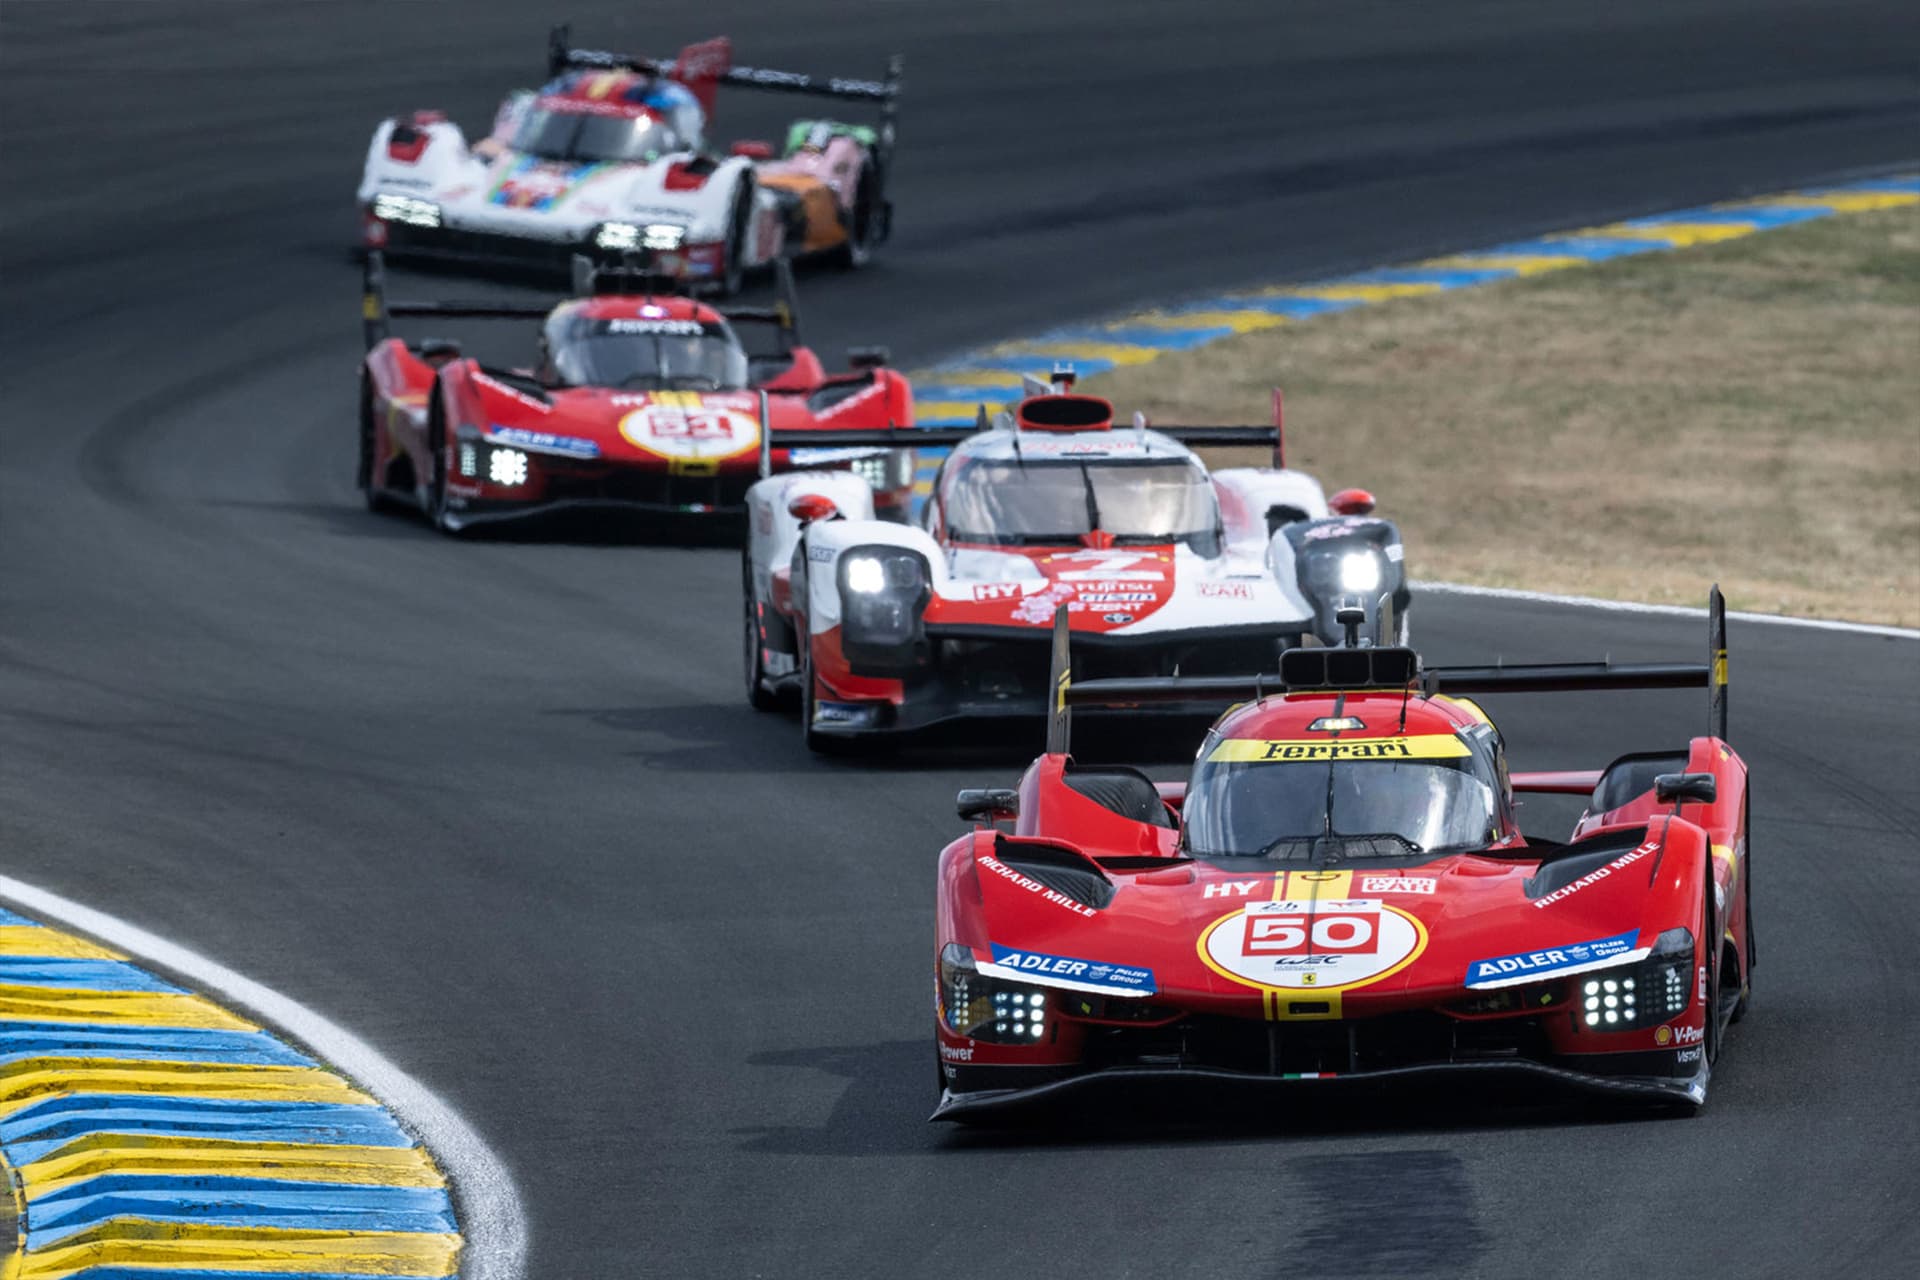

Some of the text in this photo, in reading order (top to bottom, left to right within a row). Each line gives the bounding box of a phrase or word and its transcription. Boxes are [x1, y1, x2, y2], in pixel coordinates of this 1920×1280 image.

[976, 584, 1019, 599] HY
[1260, 740, 1412, 759] Ferrari
[978, 856, 1097, 917] RICHARD MILLE
[1534, 841, 1660, 908] RICHARD MILLE
[1203, 880, 1260, 898] HY
[1250, 916, 1373, 950] 50
[996, 953, 1088, 976] ADLER
[1478, 950, 1568, 977] ADLER
